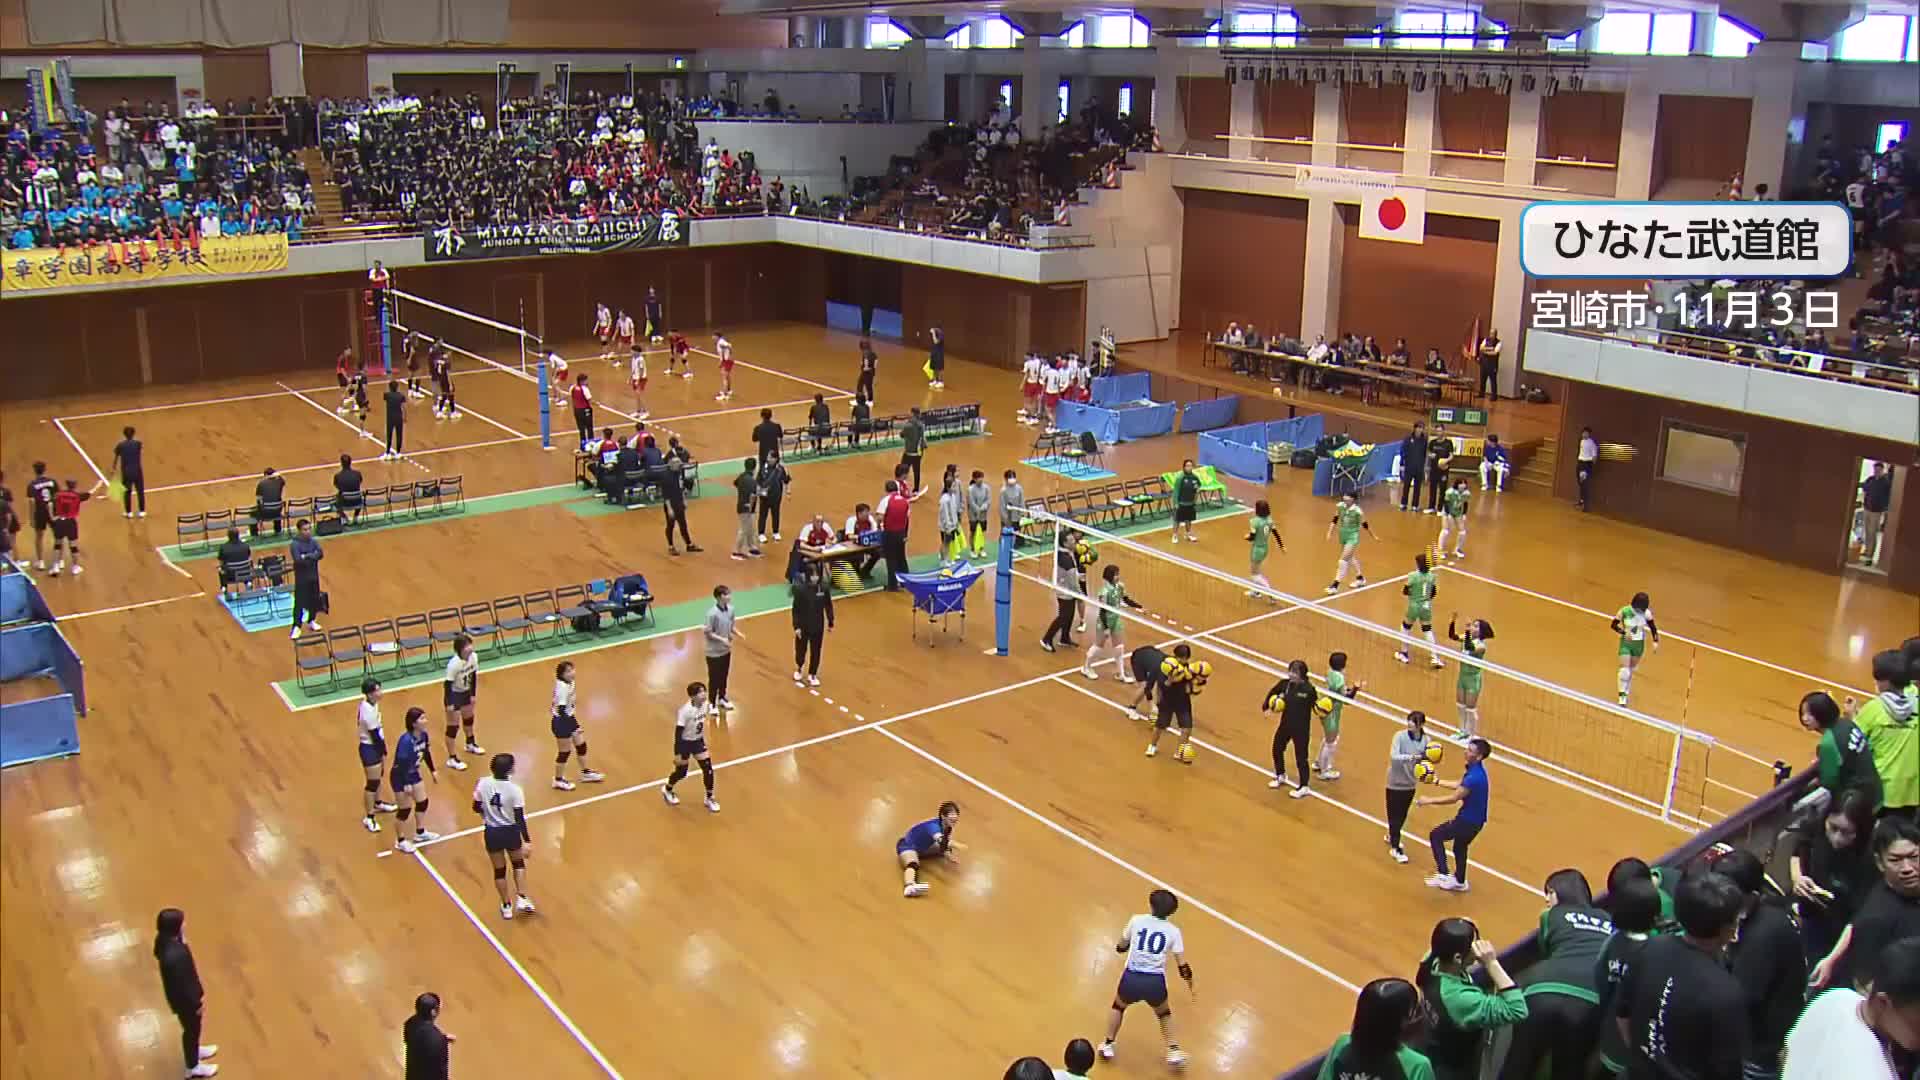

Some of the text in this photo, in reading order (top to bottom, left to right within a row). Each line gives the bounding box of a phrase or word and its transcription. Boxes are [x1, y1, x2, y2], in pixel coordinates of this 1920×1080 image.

[476, 218, 647, 240] MIYAZAKI DAIICHI
[481, 237, 521, 248] JUNIOR
[534, 233, 573, 245] SENIOR
[575, 234, 601, 244] HIGH
[0, 247, 209, 281] 章学園高等学校
[489, 792, 503, 811] 4
[1136, 927, 1167, 955] 10
